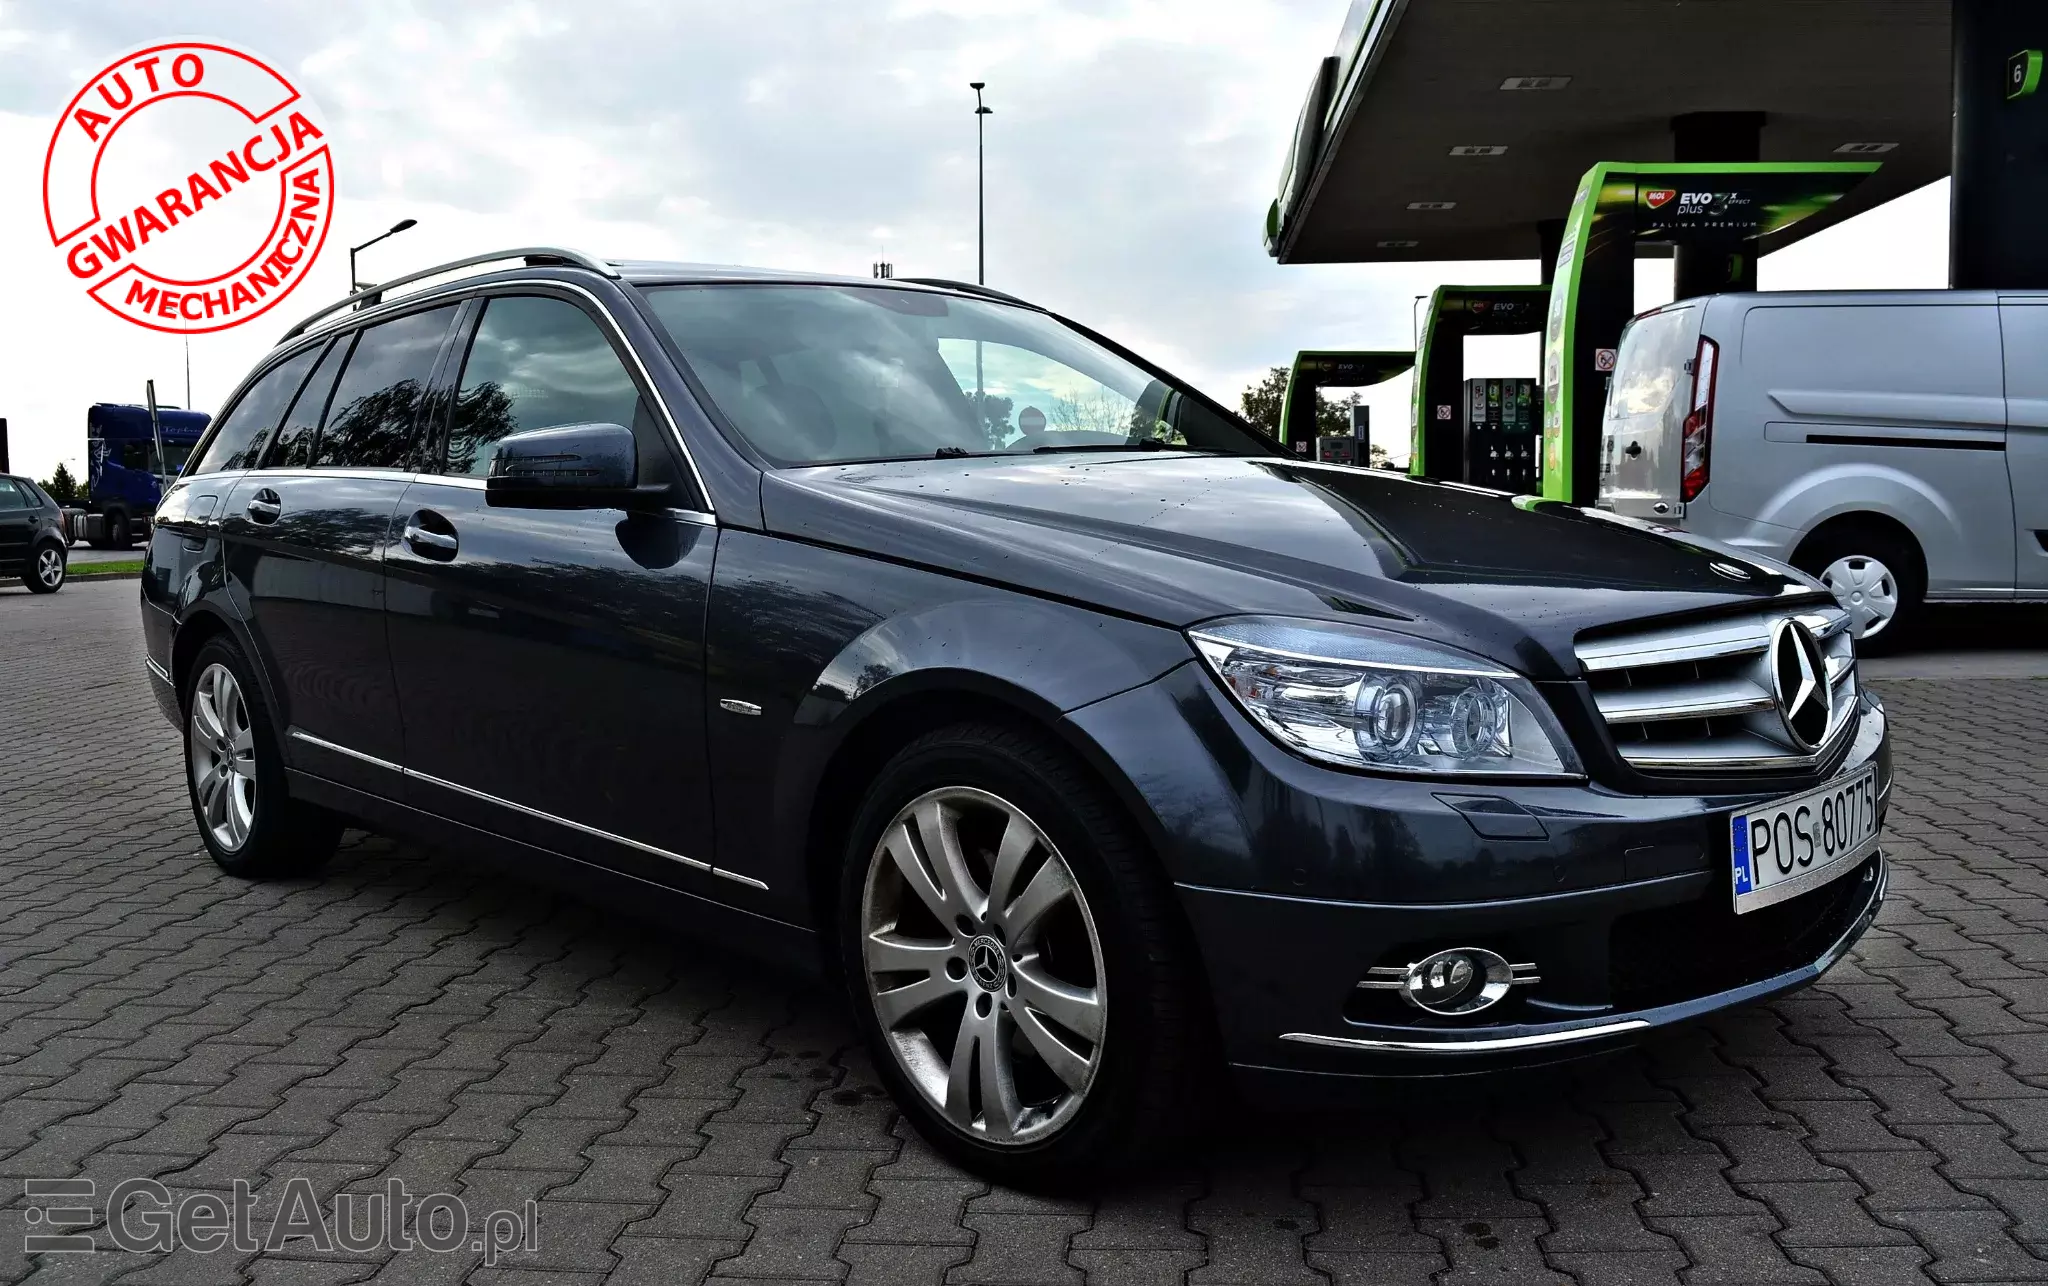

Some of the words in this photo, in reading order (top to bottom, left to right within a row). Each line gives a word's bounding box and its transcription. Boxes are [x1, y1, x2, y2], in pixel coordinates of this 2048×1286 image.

[2013, 64, 2022, 83] 6
[1648, 192, 1666, 200] MOL
[1680, 193, 1713, 204] EVO
[1677, 203, 1704, 215] plus
[1493, 302, 1515, 311] EVO
[1750, 805, 1815, 886] POS
[1821, 774, 1874, 857] 80775
[1735, 866, 1749, 885] PL
[974, 938, 1000, 954] MERCEDES
